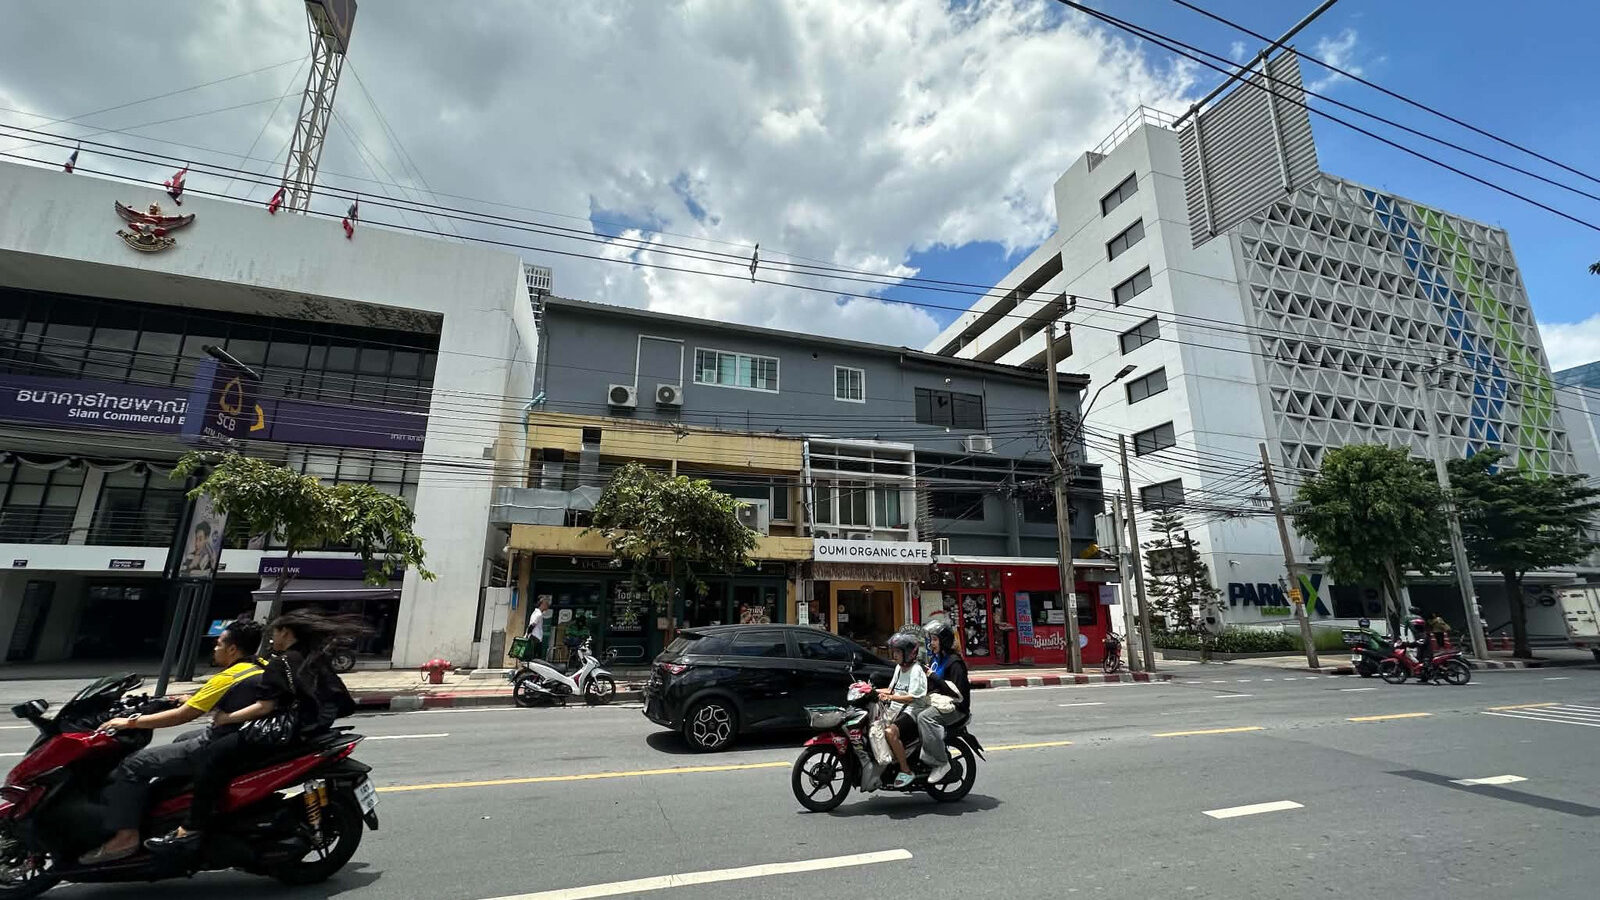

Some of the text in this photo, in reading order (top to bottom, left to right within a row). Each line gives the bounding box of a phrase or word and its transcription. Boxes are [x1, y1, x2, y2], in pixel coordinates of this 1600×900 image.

[16, 390, 189, 414] ธนาคารไทยพาณิ
[68, 408, 100, 419] Siam
[103, 410, 175, 424] Commercial
[216, 412, 236, 431] SCB
[819, 545, 927, 558] OUMI ORGANIC CAFE
[263, 566, 301, 574] EASYANK
[1228, 582, 1291, 606] PARK
